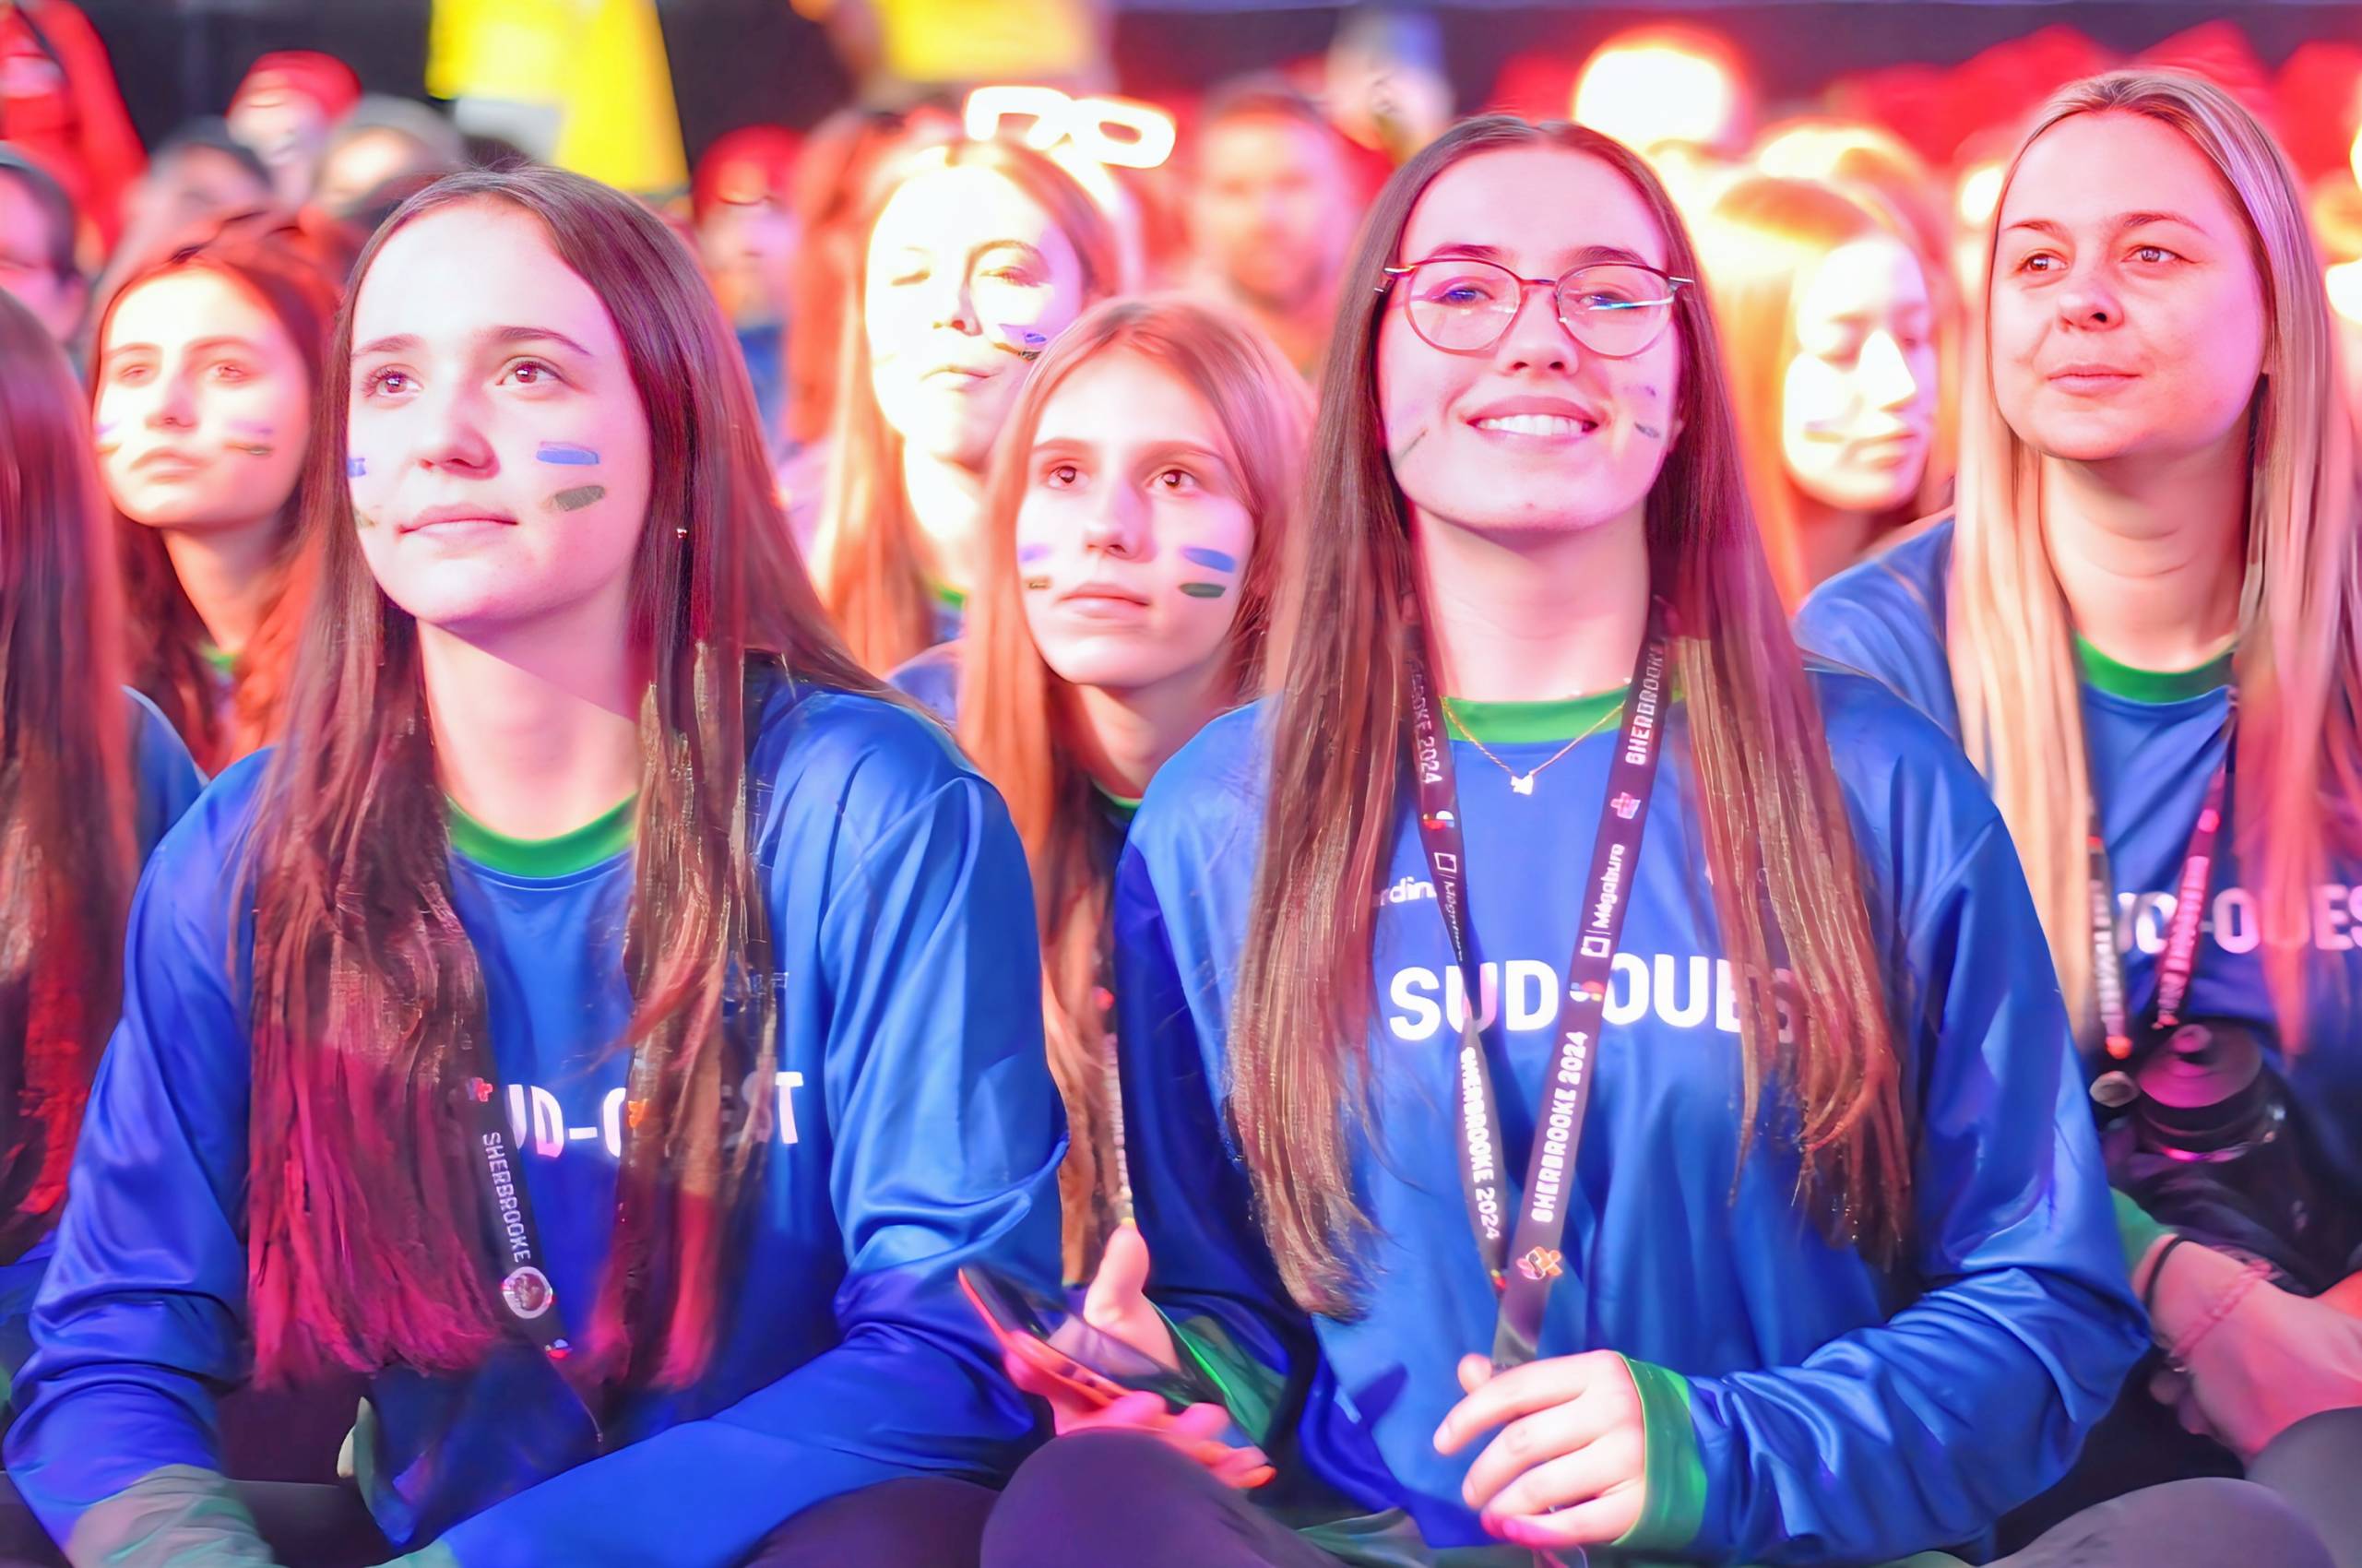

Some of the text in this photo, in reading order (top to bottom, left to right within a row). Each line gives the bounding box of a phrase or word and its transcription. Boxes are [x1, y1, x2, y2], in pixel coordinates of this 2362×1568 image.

[1419, 736, 1443, 785] 2024
[1531, 1031, 1589, 1224] SHERBROOKE 2024
[482, 1131, 531, 1264] SHERBROOKE
[1476, 1187, 1501, 1240] 2024
